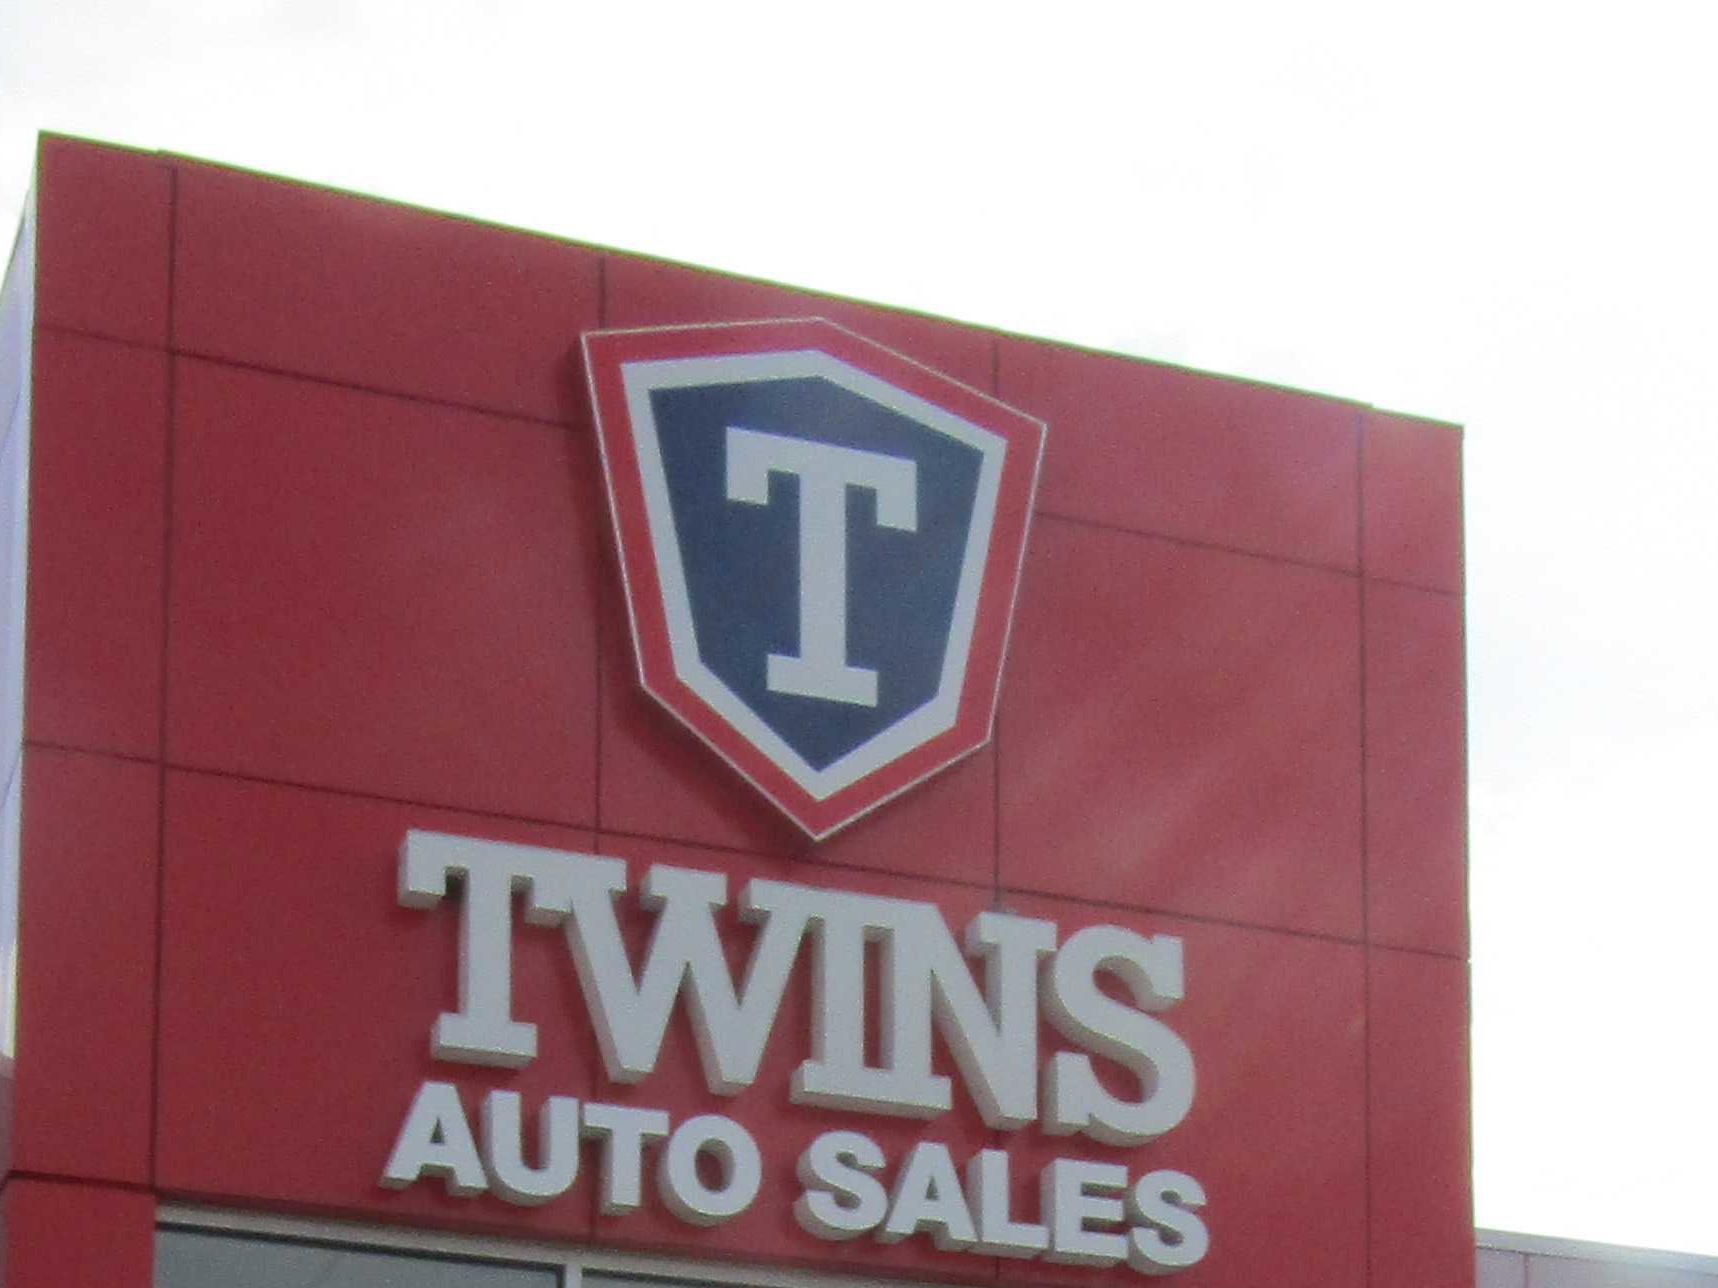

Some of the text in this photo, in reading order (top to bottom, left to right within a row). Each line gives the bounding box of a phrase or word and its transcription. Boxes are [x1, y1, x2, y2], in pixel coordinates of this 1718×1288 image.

[726, 426, 918, 708] T
[397, 828, 1197, 1147] TWINS
[379, 1080, 1209, 1276] AUTO SALES
